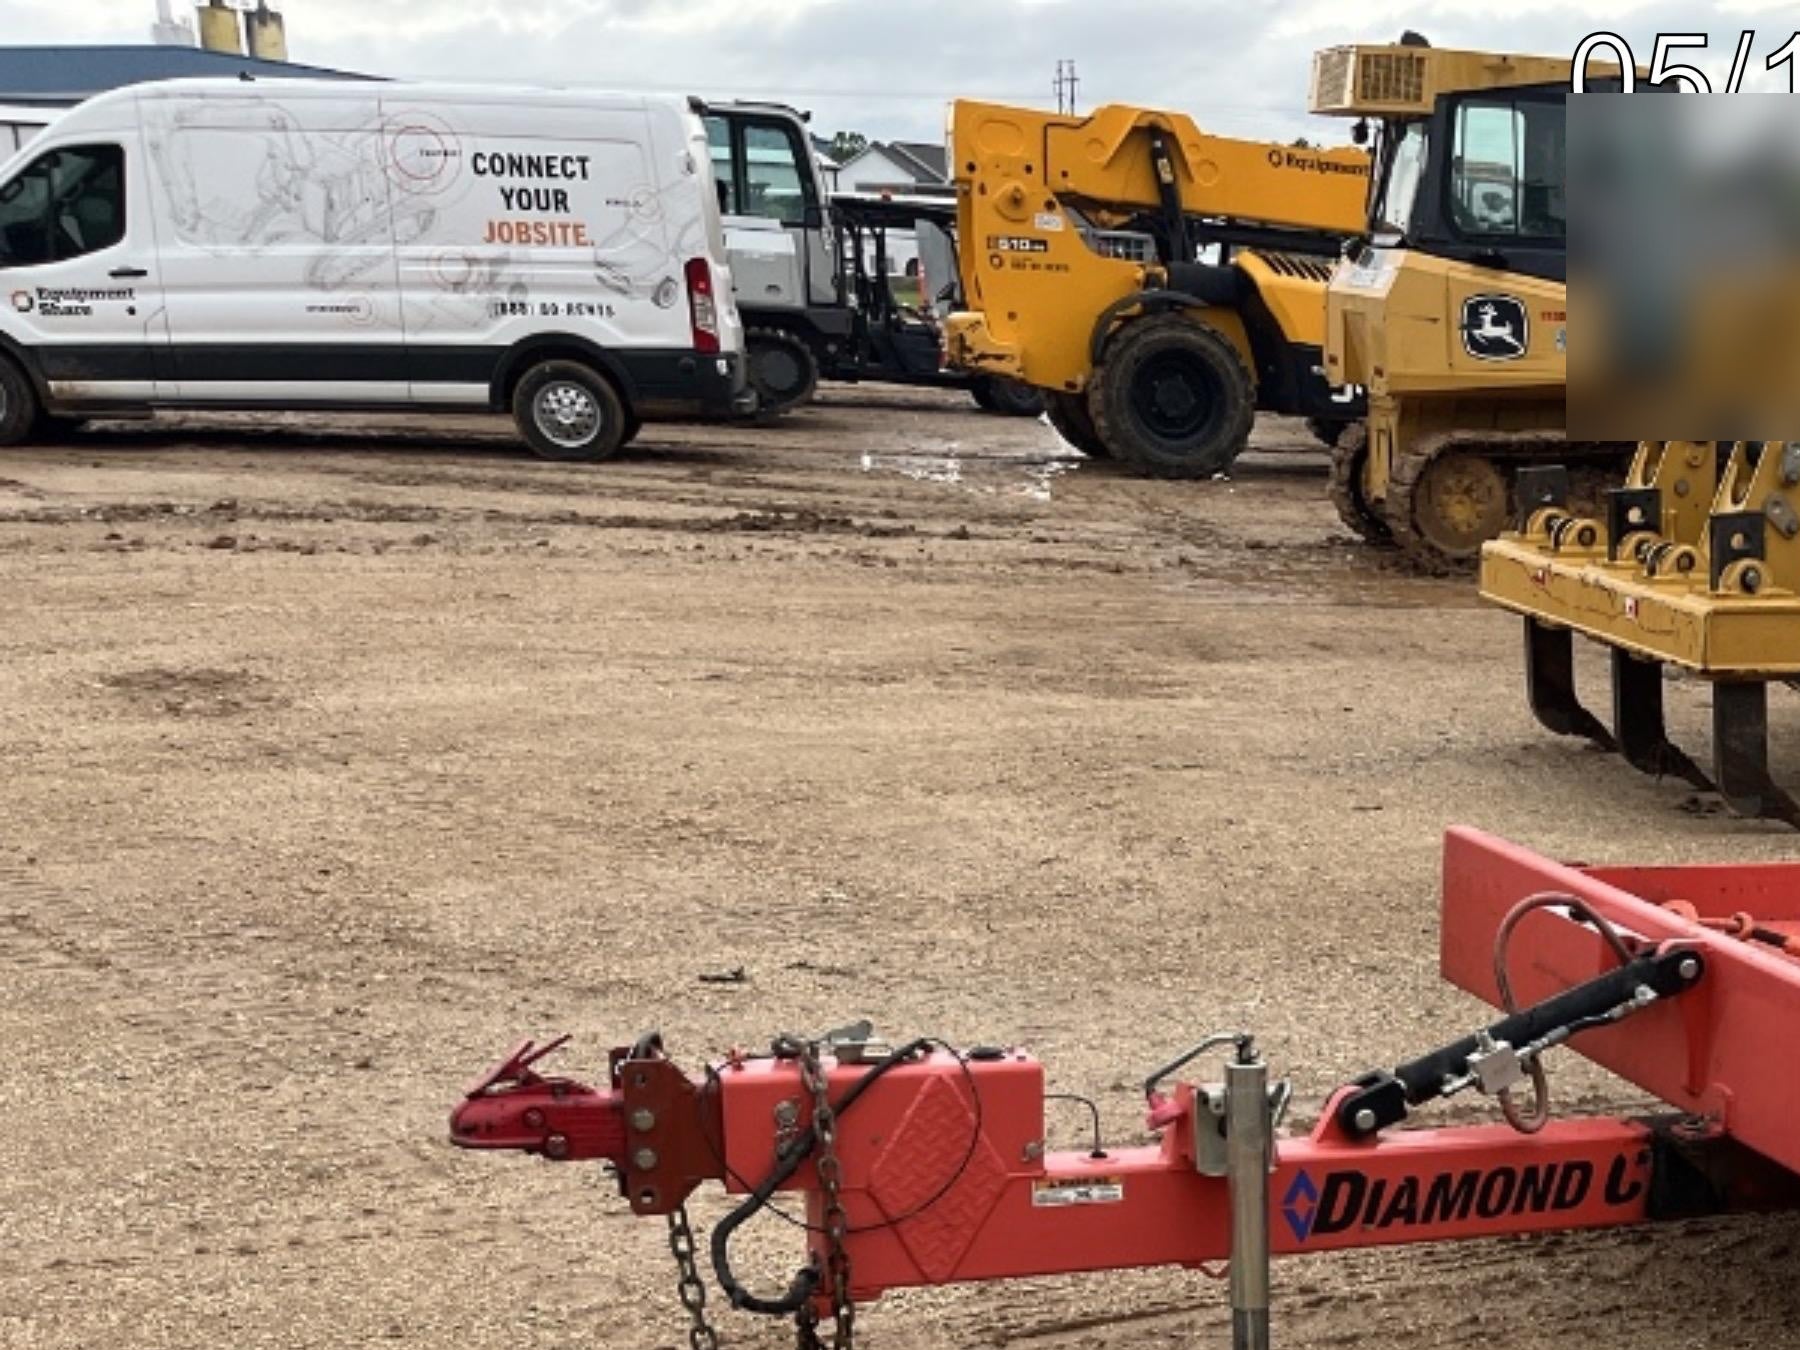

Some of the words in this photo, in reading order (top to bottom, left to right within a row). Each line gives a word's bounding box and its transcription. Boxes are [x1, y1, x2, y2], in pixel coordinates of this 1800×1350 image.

[471, 151, 591, 181] CONNECT
[499, 185, 571, 214] YOUR
[482, 220, 596, 247] JOBSITE.
[36, 287, 136, 303] Equipment
[38, 301, 93, 316] Share
[1311, 1159, 1594, 1234] DIAMOND
[1604, 1148, 1651, 1206] C
